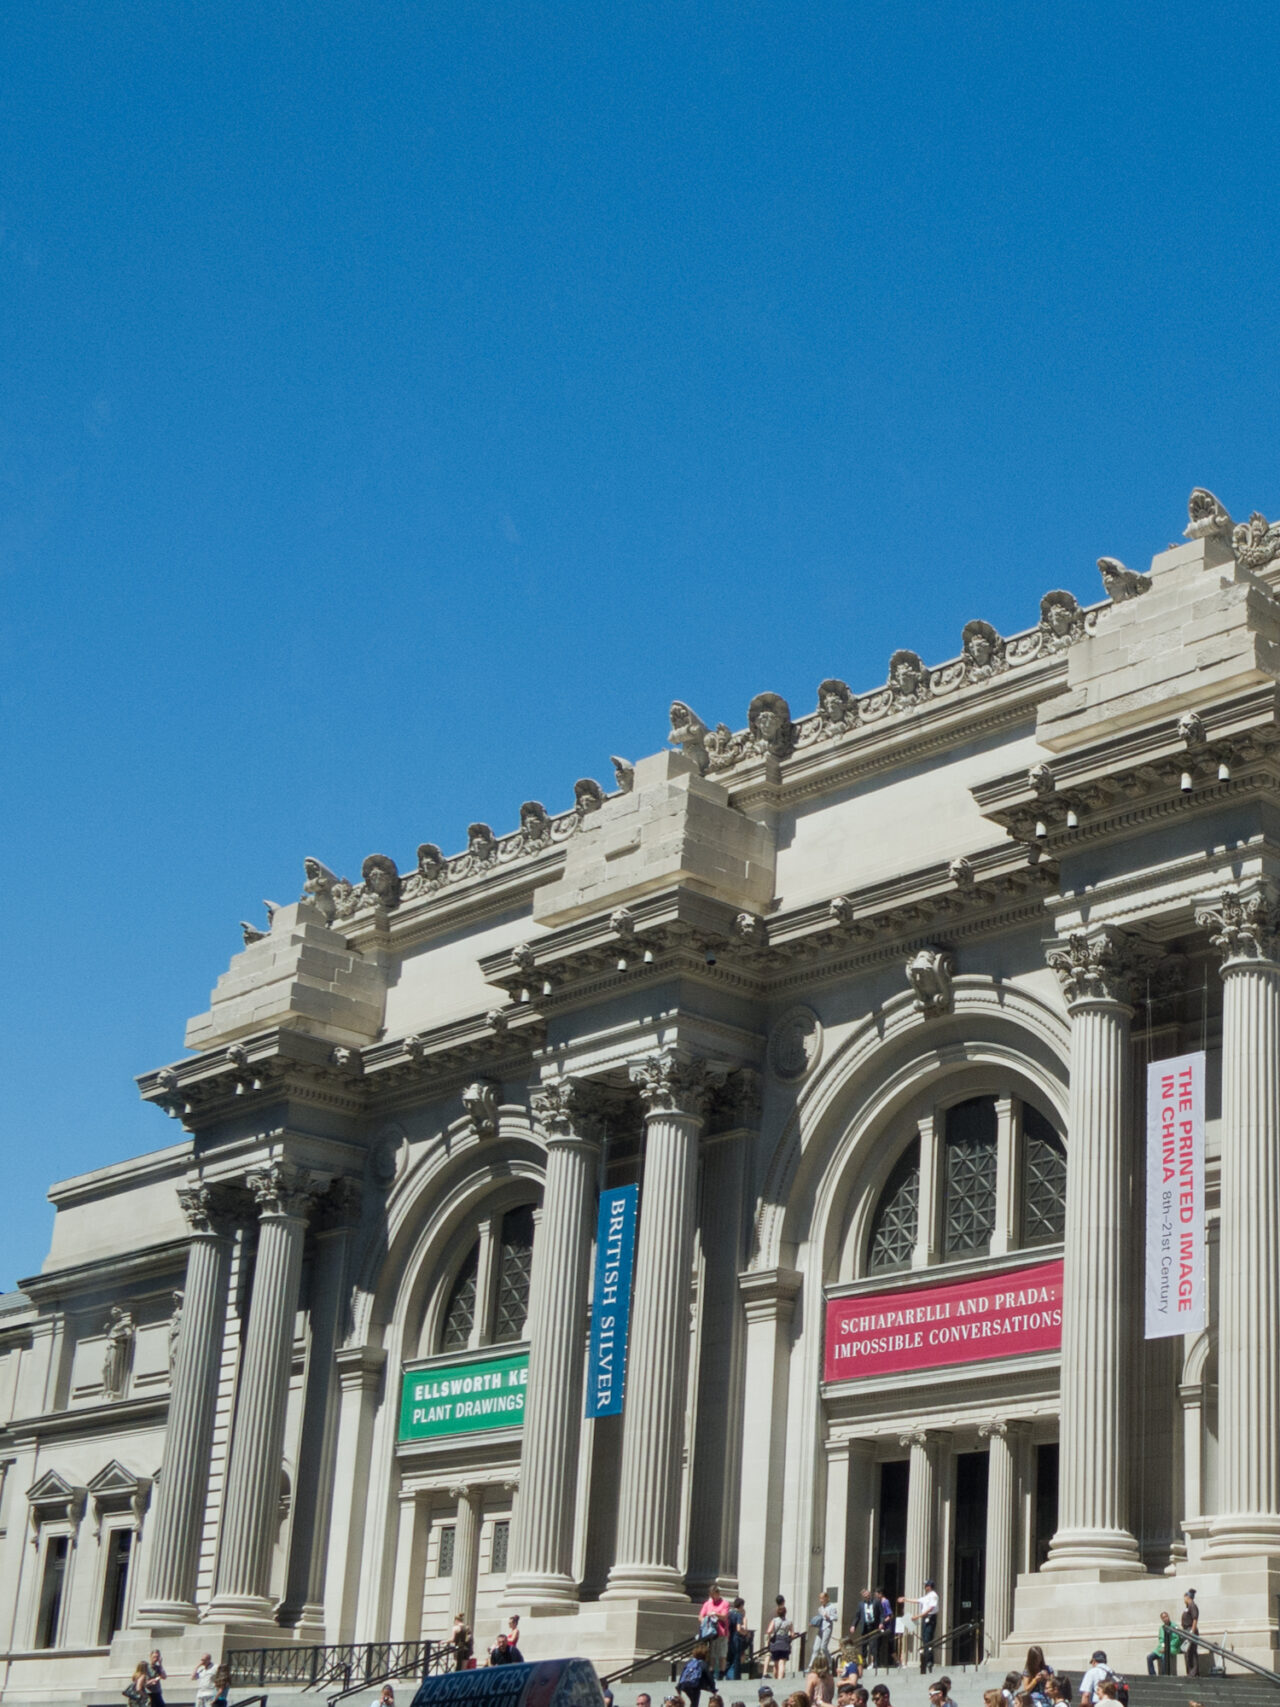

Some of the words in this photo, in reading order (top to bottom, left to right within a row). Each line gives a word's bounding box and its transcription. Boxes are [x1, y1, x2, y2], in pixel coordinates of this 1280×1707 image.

[1161, 1074, 1175, 1100] IN
[1178, 1066, 1193, 1113] THE
[1161, 1106, 1176, 1184] CHINA
[1178, 1120, 1194, 1224] PRINTED
[602, 1198, 626, 1306] BRITISH
[1178, 1232, 1193, 1313] IMAGE
[840, 1302, 951, 1335] SCHIAPARELLI
[956, 1296, 990, 1318] AND
[994, 1285, 1056, 1311] PRADA:
[1157, 1256, 1173, 1315] Century
[833, 1331, 924, 1360] IMPOSSIBLE
[928, 1308, 1063, 1346] CONVERSATIONS
[414, 1372, 503, 1401] ELLSWORTH
[596, 1315, 616, 1410] SILVER
[412, 1404, 453, 1425] PLANT
[455, 1393, 525, 1419] DRAWINGS
[414, 1667, 531, 1703] FLASHDANCERS
